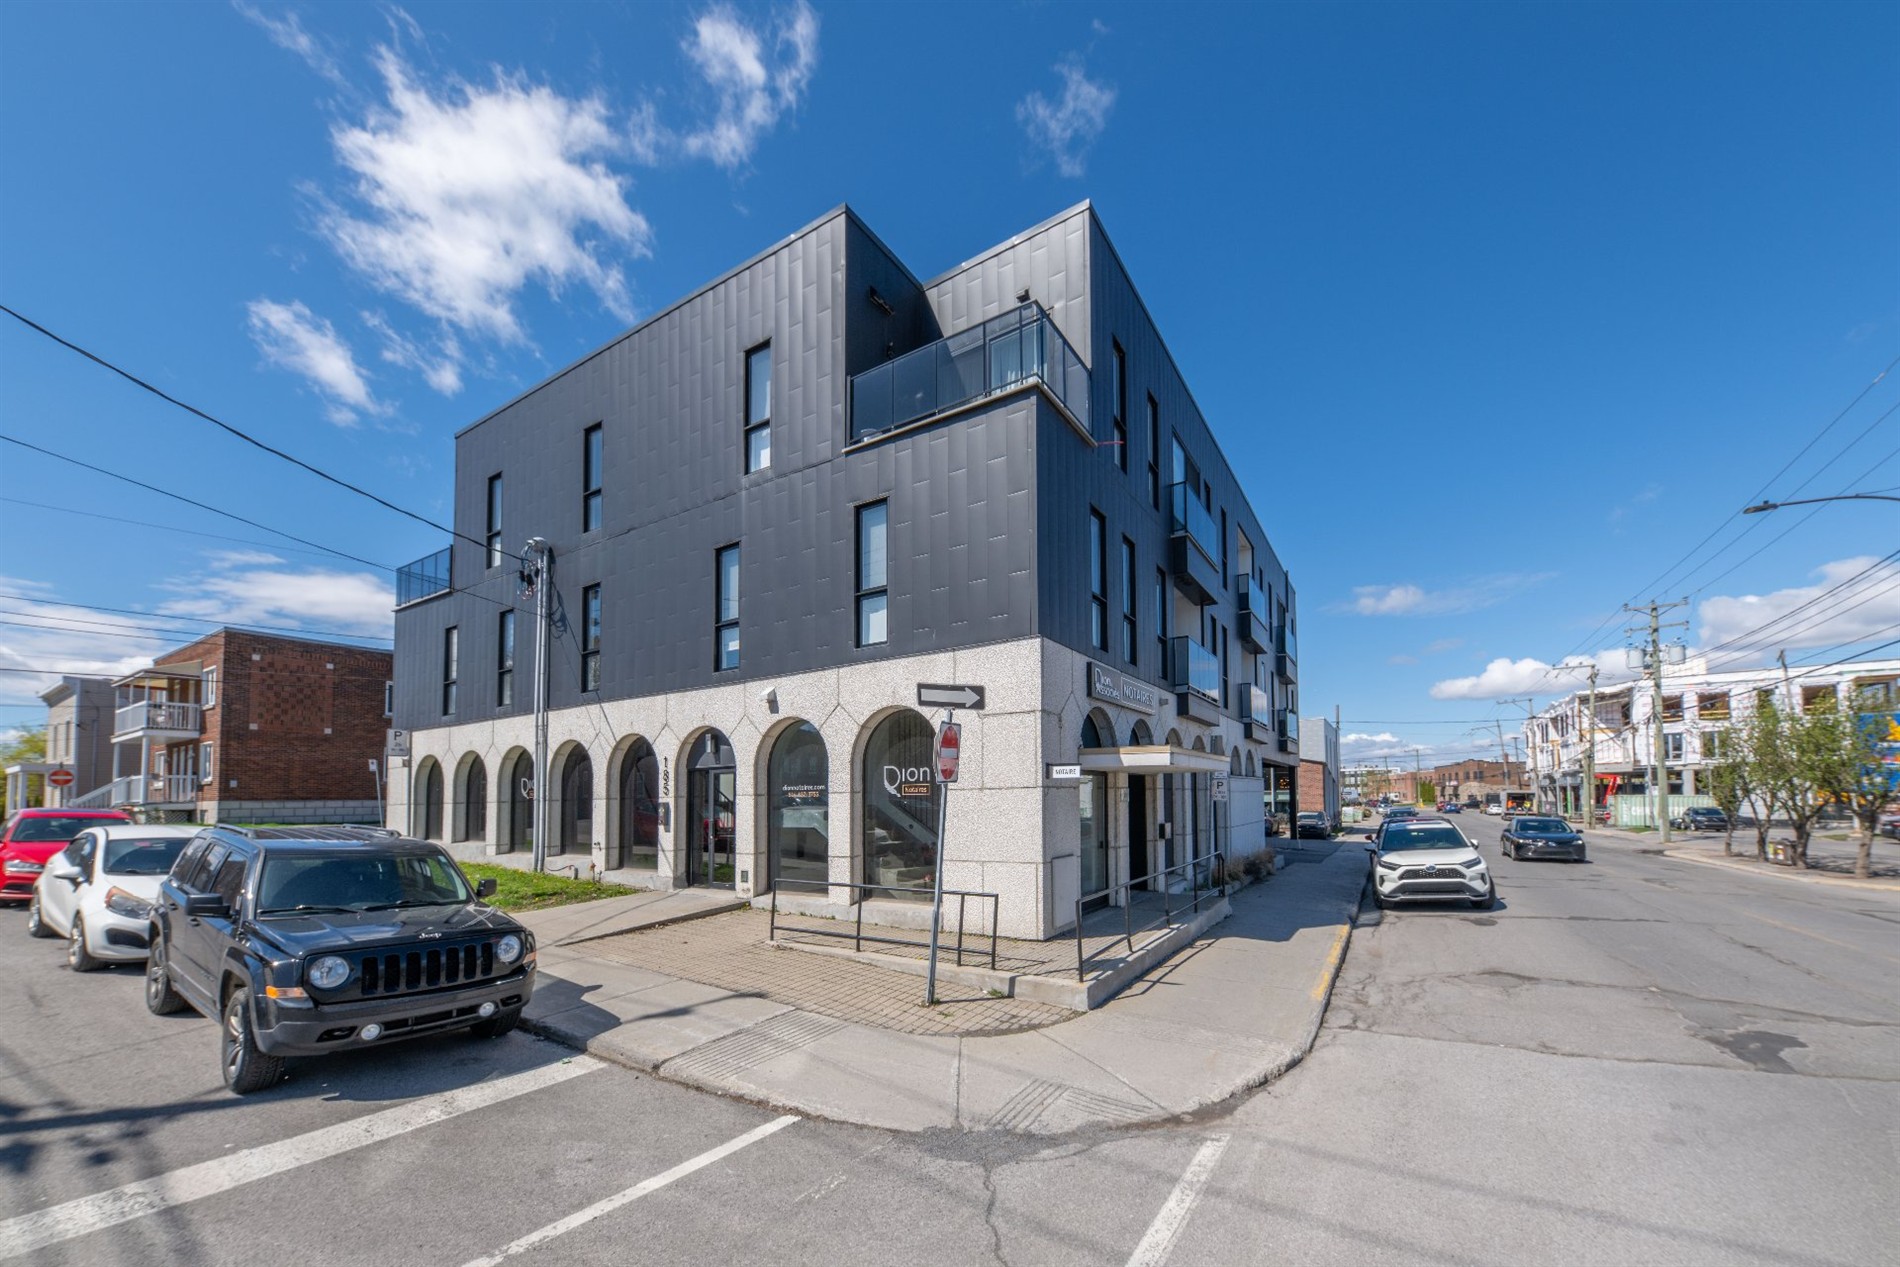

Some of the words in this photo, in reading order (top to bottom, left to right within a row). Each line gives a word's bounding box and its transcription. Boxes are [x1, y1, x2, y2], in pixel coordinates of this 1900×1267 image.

[1123, 684, 1153, 706] NOTAIRES
[394, 731, 402, 740] P
[884, 765, 930, 796] Dion
[1217, 781, 1224, 789] P
